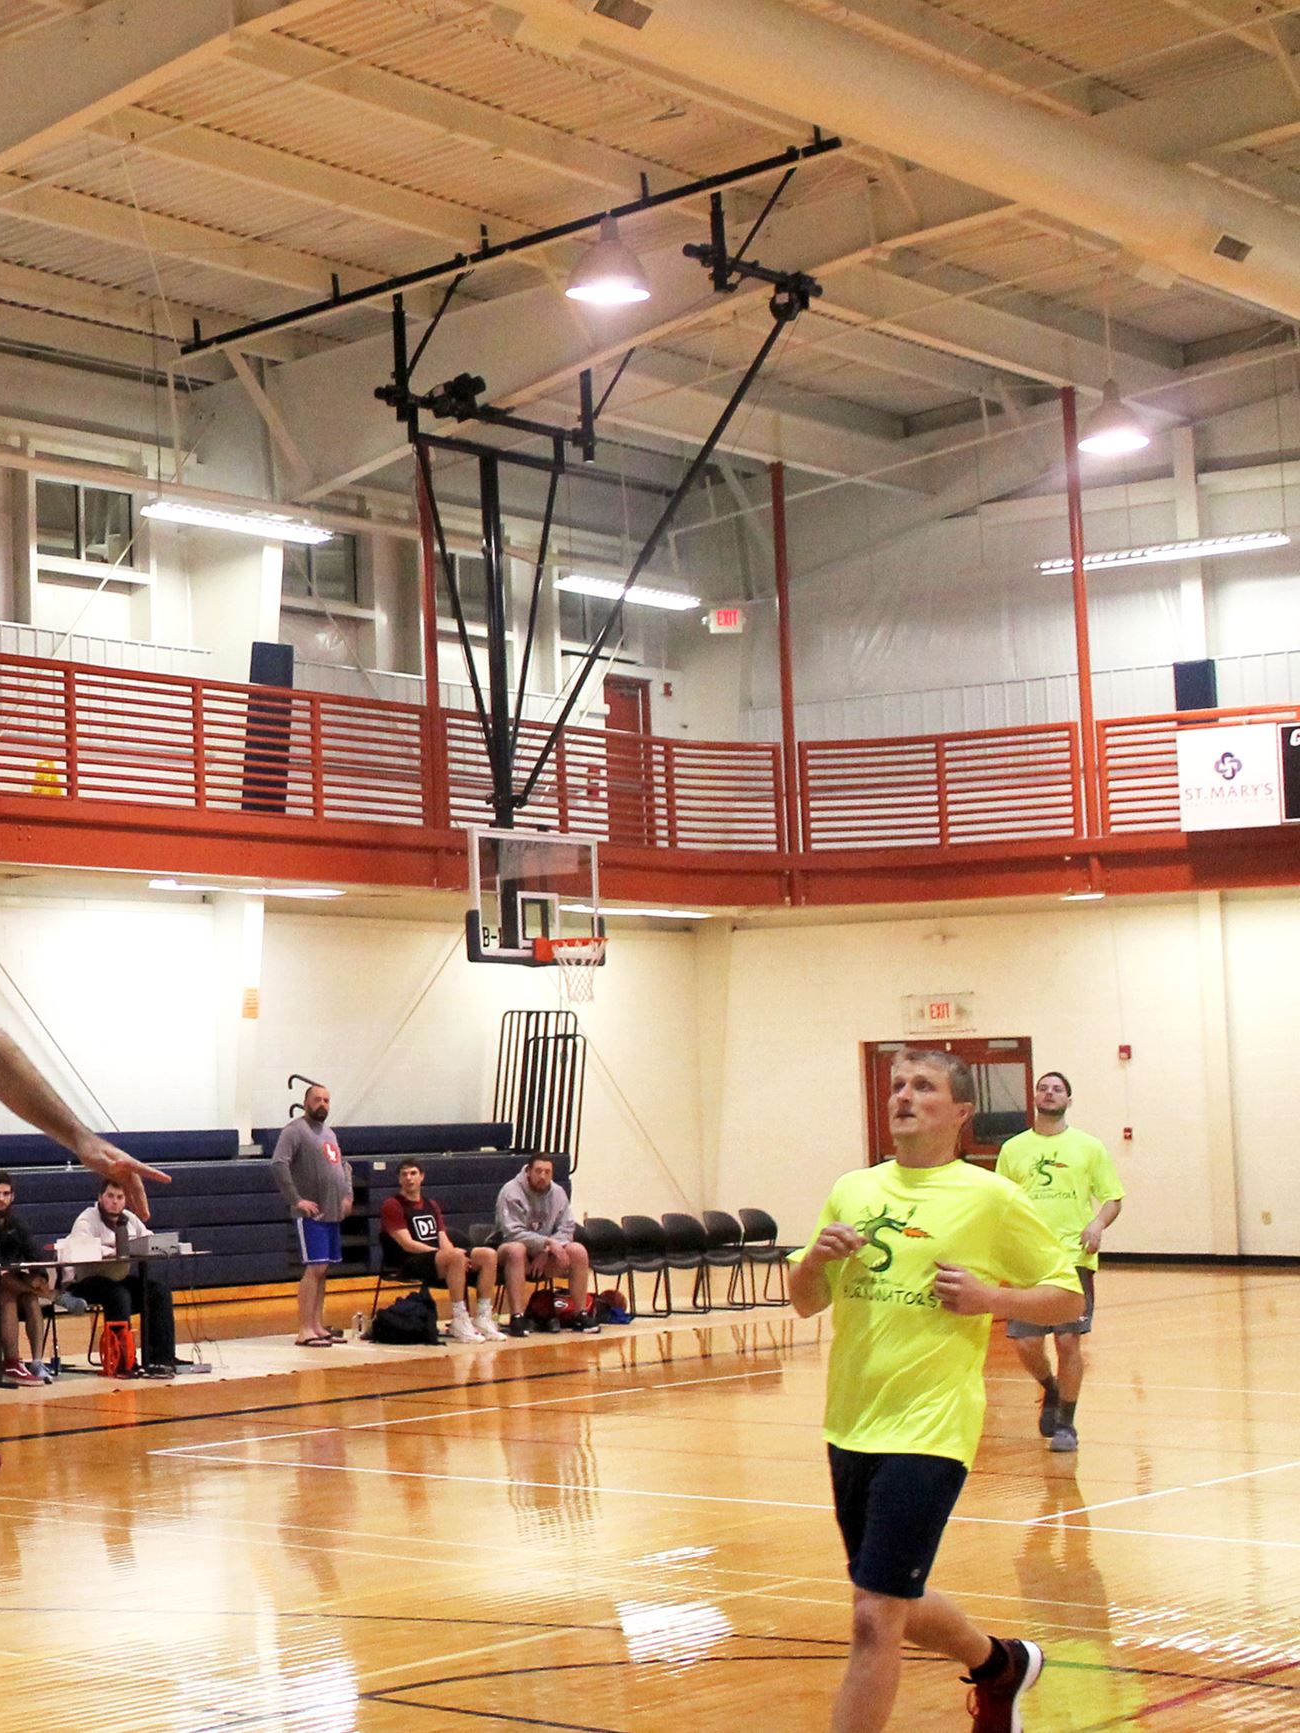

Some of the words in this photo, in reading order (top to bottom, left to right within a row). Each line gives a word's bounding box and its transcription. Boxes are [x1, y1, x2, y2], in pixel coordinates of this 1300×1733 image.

[716, 609, 739, 626] EXIT
[930, 1002, 949, 1019] EXIT
[418, 1219, 435, 1235] D1
